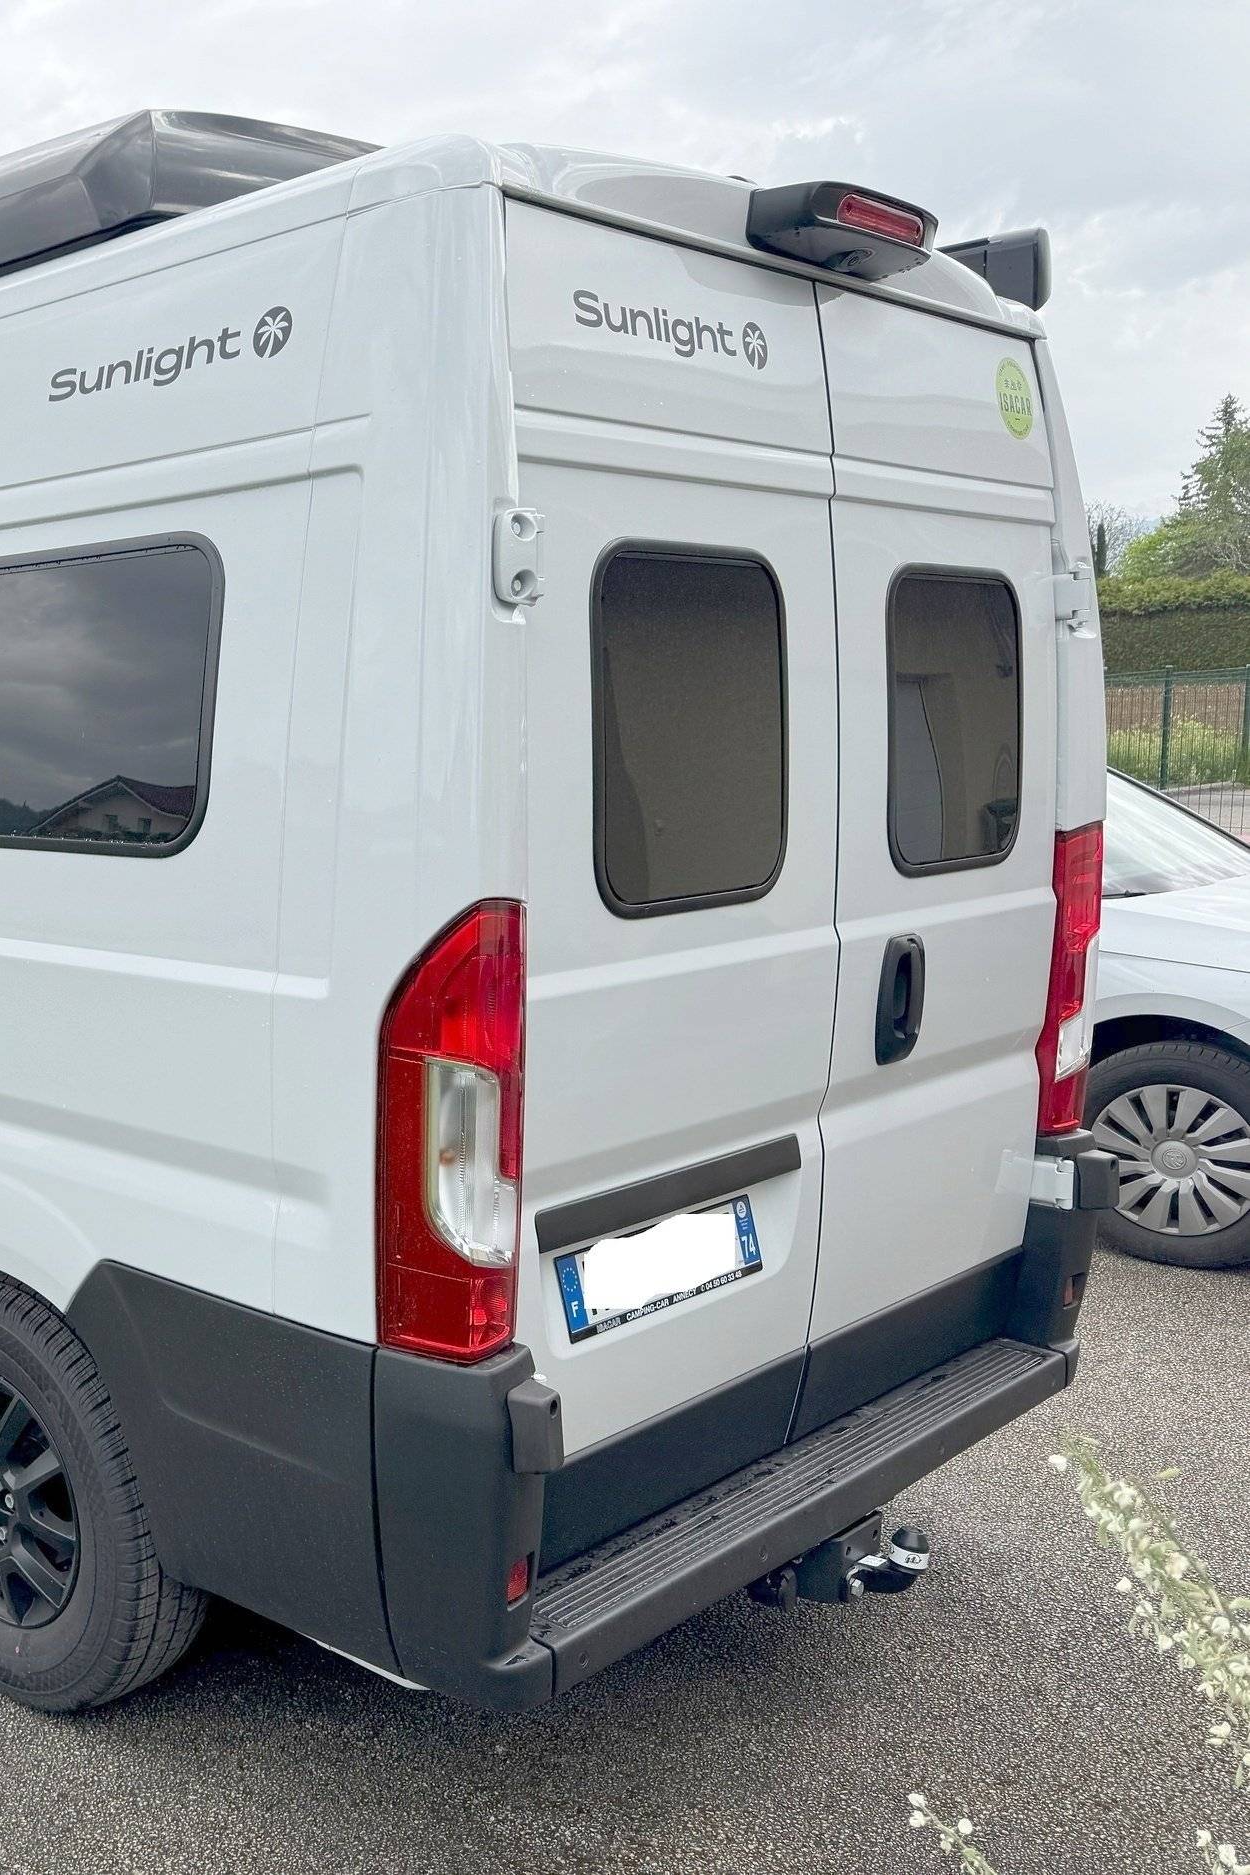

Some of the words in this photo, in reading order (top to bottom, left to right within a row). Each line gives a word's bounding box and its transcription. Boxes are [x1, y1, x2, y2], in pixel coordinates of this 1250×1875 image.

[573, 289, 737, 358] Sunlight
[49, 327, 241, 402] Sunlight
[999, 391, 1033, 417] ISACAR
[741, 1232, 756, 1258] 74
[570, 1300, 579, 1318] F
[626, 1298, 670, 1321] CAMPING-CAR
[673, 1287, 697, 1303] ANNECY
